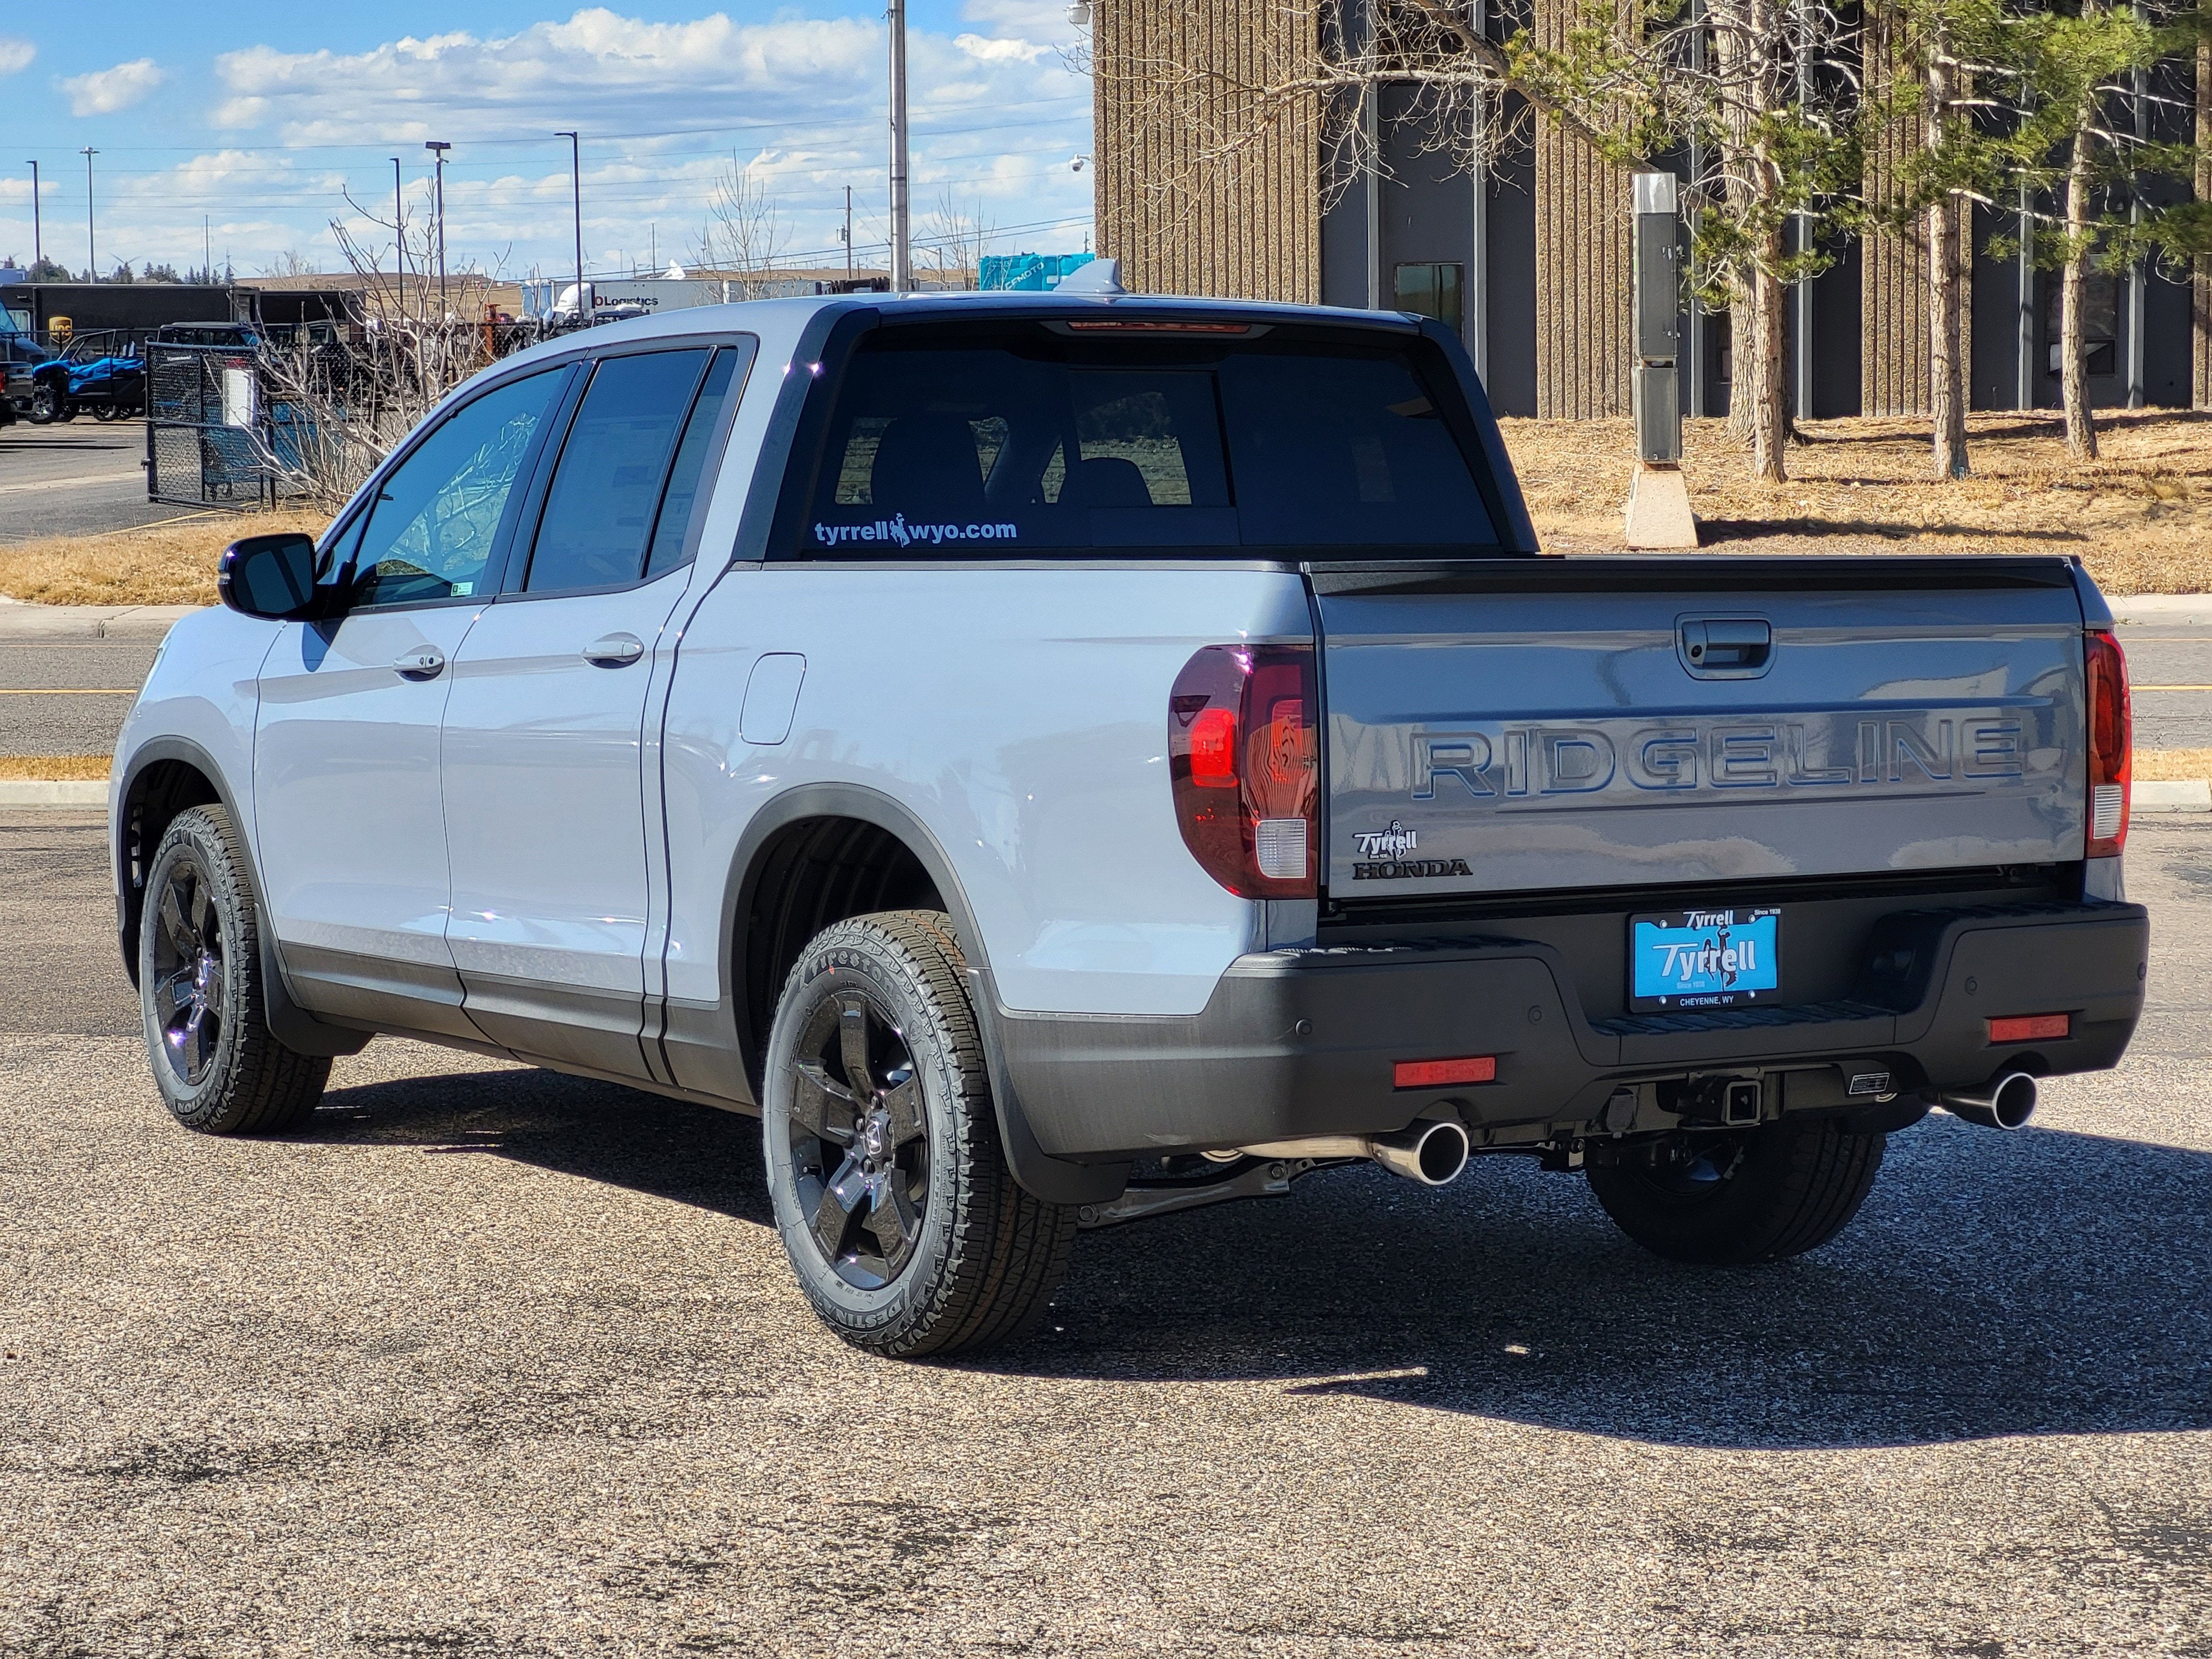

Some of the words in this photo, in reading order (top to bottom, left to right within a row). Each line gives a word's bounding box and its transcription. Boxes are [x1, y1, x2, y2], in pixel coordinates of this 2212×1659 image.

[1410, 717, 2022, 800] RIDGELINE
[1354, 831, 1417, 854] Tyrrell
[1353, 859, 1473, 880] HONDA
[1683, 910, 1734, 929] Tyrrell
[1652, 940, 1756, 981] Tyrrell
[1680, 996, 1720, 1006] CHEYENNE,
[1722, 995, 1734, 1004] WY
